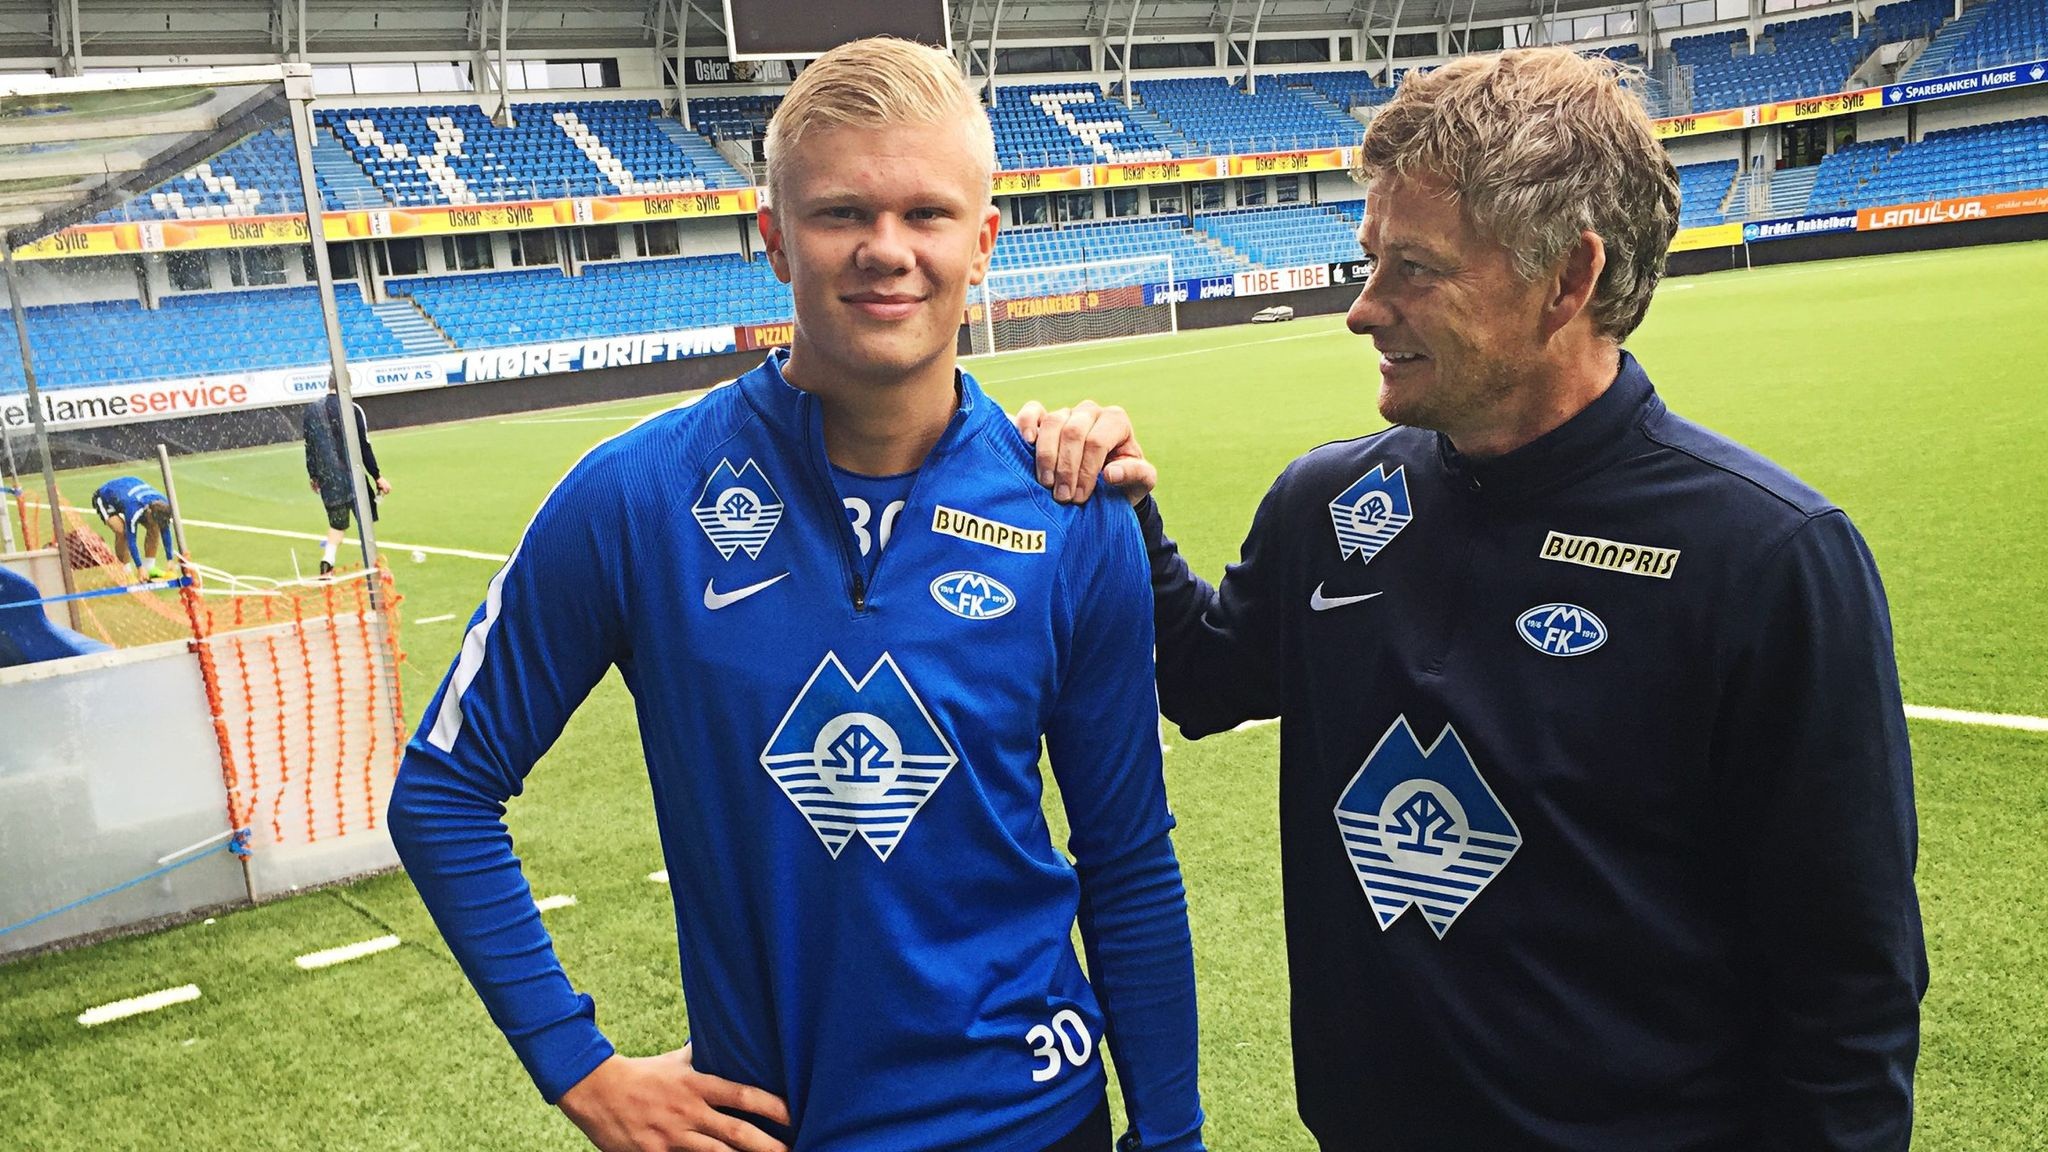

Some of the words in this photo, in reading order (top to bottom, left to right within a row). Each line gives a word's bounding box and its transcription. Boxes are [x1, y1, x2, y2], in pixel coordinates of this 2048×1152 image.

[694, 59, 731, 81] Oskar
[753, 60, 783, 82] Sylte
[1905, 77, 1978, 99] SPAREBANKEN
[1981, 71, 2017, 86] MØRE
[1795, 100, 1823, 117] Oskar
[1842, 93, 1864, 111] Sylte
[1674, 118, 1696, 134] Sylte
[1122, 165, 1145, 181] Oskar
[1162, 162, 1180, 181] Sylte
[1255, 155, 1277, 171] Oskar
[1291, 153, 1308, 171] Sylte
[1020, 171, 1041, 191] Sylte
[644, 196, 674, 215] Oskar
[695, 195, 720, 215] Sylte
[448, 208, 482, 228] Oskar
[506, 206, 534, 227] Sylte
[228, 219, 267, 240] Oskar
[54, 230, 89, 254] Sylte
[1241, 271, 1280, 293] TIBE
[1287, 266, 1324, 289] TIBE
[1153, 288, 1188, 305] KPMG
[1200, 283, 1233, 299] KPMG
[376, 373, 409, 384] BMV
[414, 370, 434, 380] AS
[464, 350, 572, 382] MØRE
[294, 381, 327, 391] BMV
[936, 508, 1044, 551] BUNNPRIS
[1545, 537, 1677, 576] BUNNPRIS
[958, 592, 985, 617] FK
[1542, 626, 1575, 654] FK
[1024, 1008, 1092, 1082] 30
